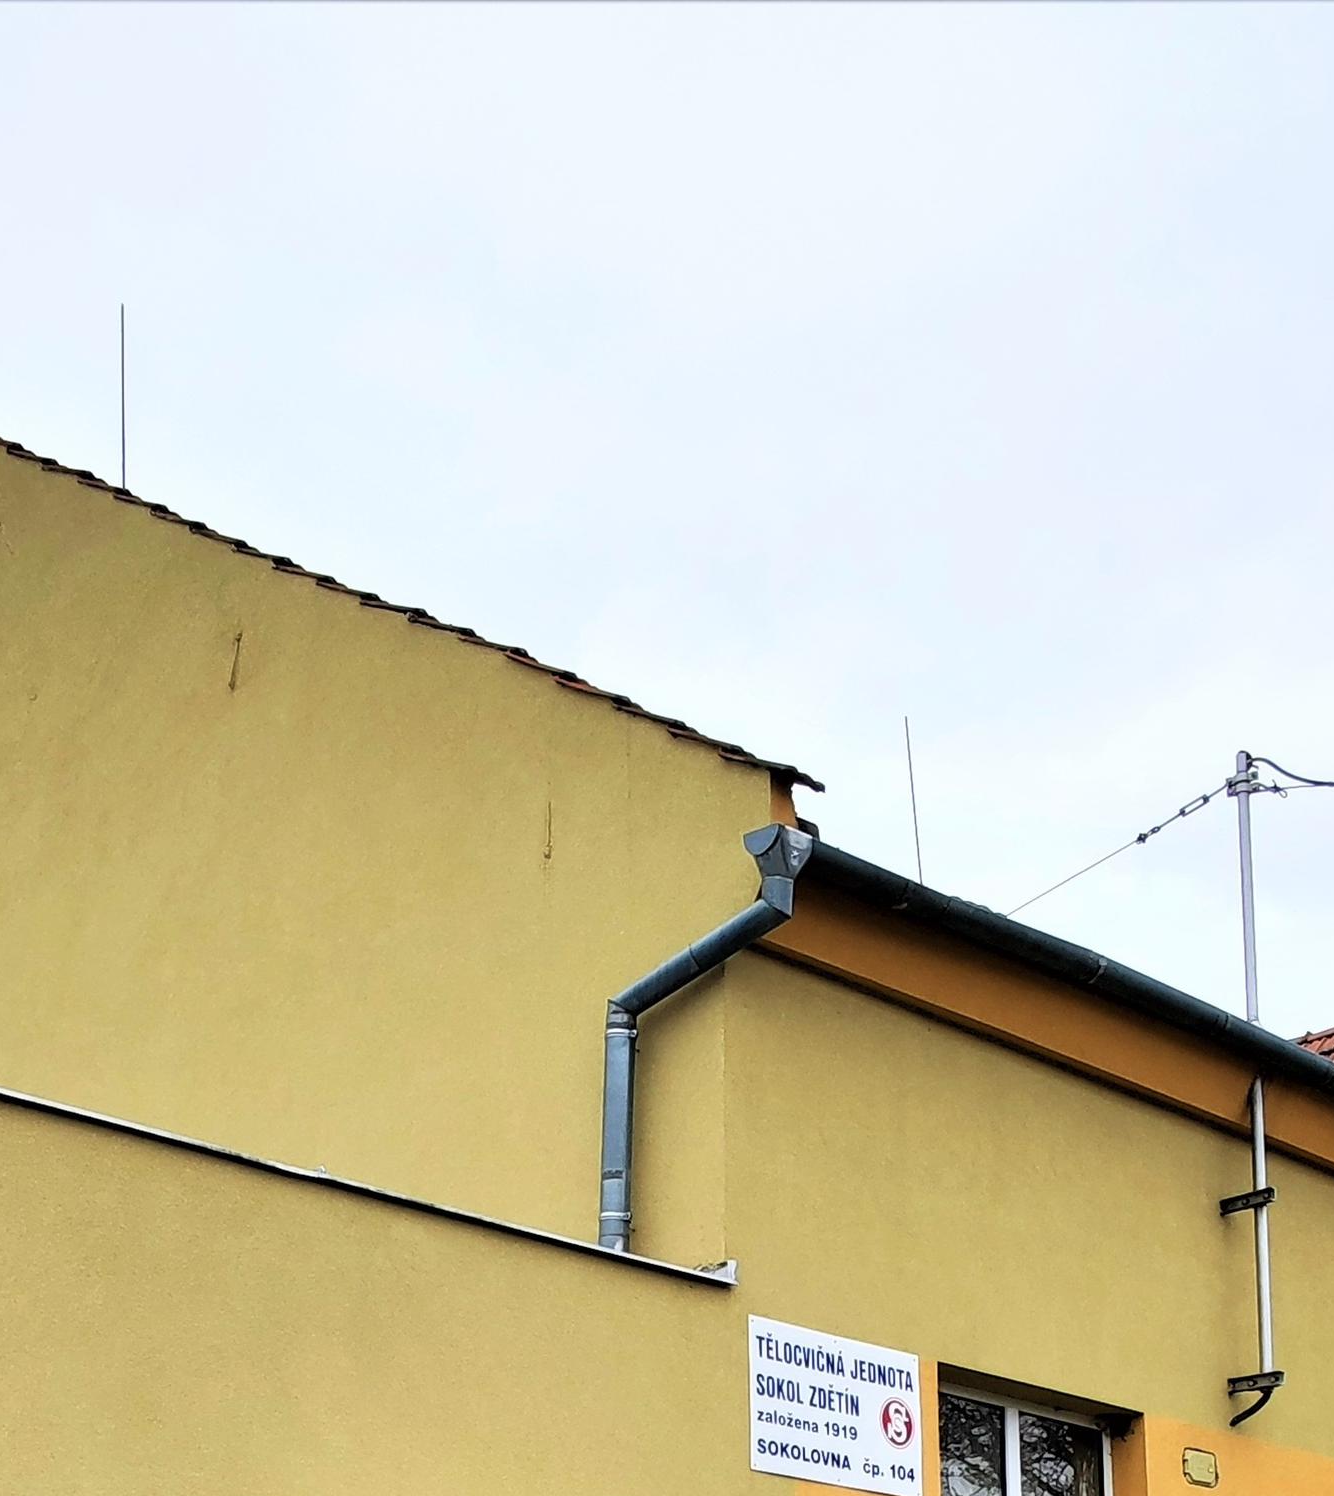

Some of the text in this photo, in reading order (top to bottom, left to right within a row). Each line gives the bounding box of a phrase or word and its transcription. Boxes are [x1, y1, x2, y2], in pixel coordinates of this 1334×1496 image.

[756, 1333, 913, 1392] TĚLOCVIČNÁ JEDNOTA
[756, 1373, 860, 1417] SOKOL ZDĚTÍN
[757, 1410, 858, 1440] založena 1919
[757, 1438, 916, 1482] SOKOLOVNA čp. 104
